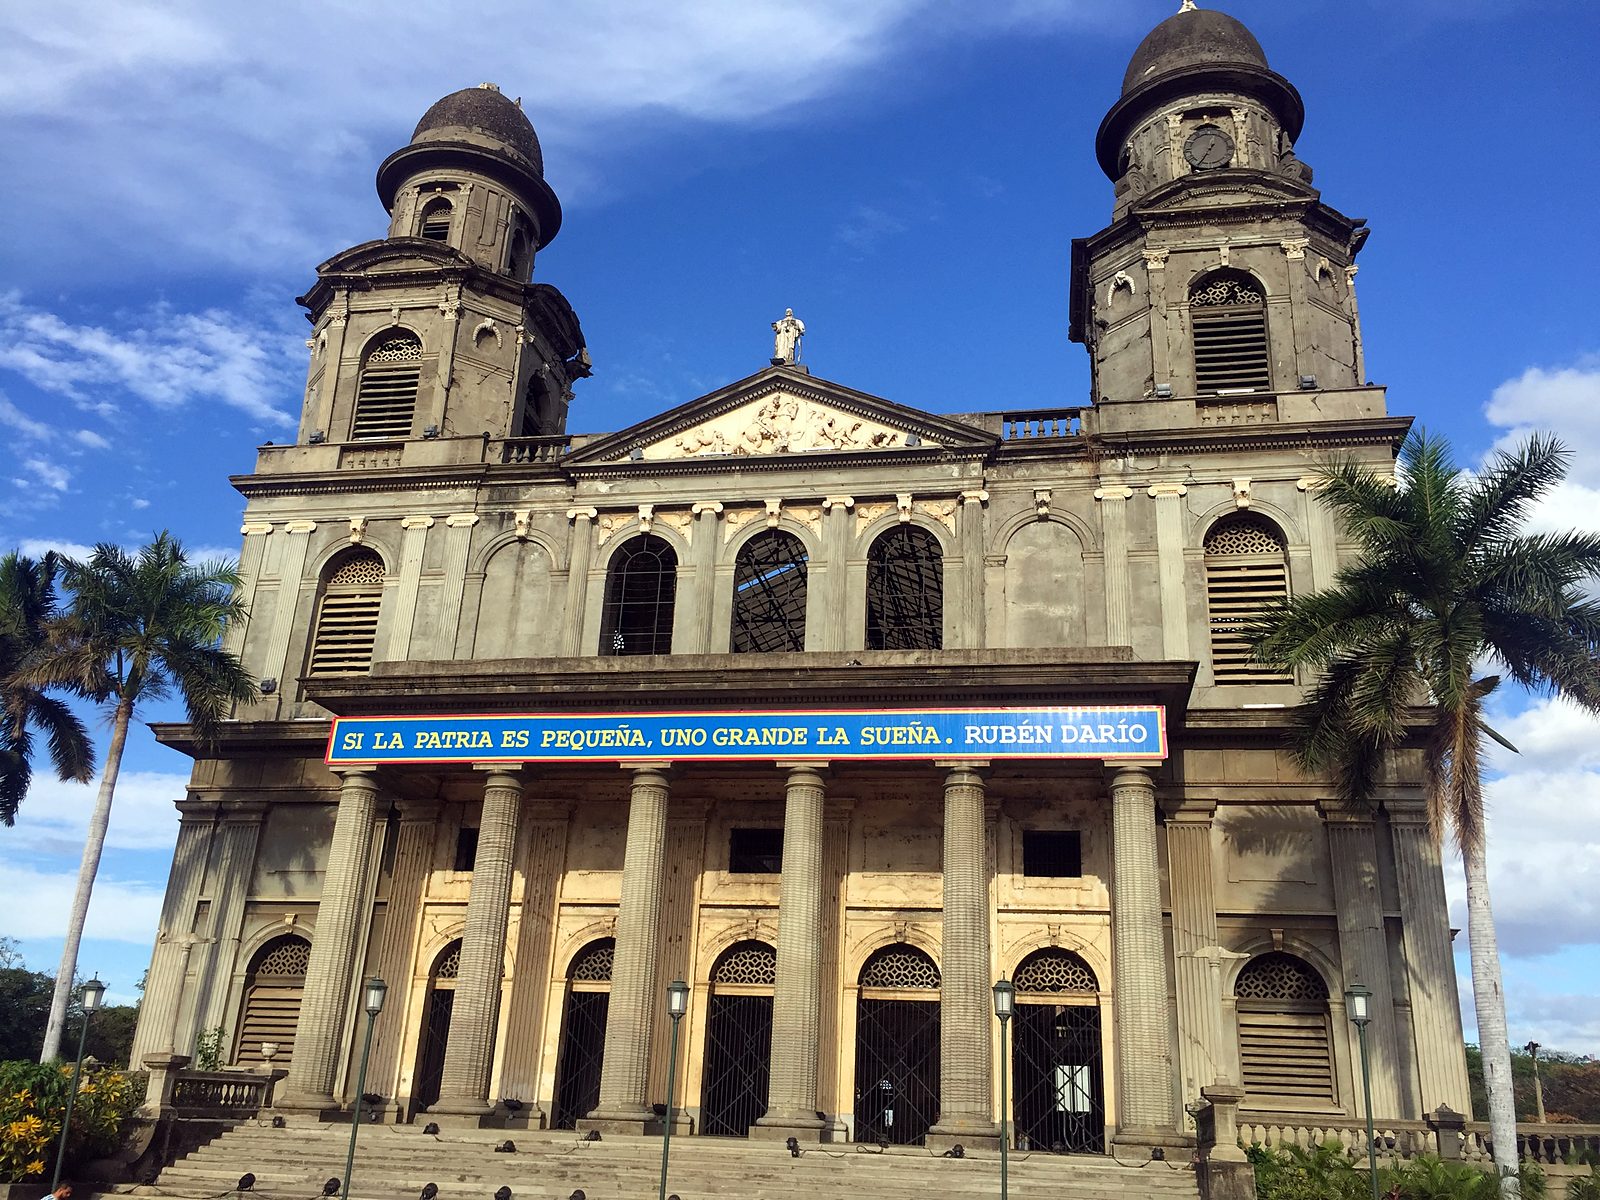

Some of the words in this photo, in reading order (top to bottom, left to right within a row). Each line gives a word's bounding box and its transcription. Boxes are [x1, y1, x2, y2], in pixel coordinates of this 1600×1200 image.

[342, 732, 364, 750] SI
[372, 732, 404, 750] LA
[414, 731, 493, 749] PATRIA
[501, 730, 530, 748] ES
[540, 724, 653, 751] PEQUEÑA,
[660, 728, 707, 747] UNO
[712, 727, 808, 747] GRANDE
[817, 727, 850, 745] LA
[860, 721, 953, 745] SUEÑA.
[964, 719, 1053, 745] RUBÉN
[1060, 718, 1148, 744] DARÍO
